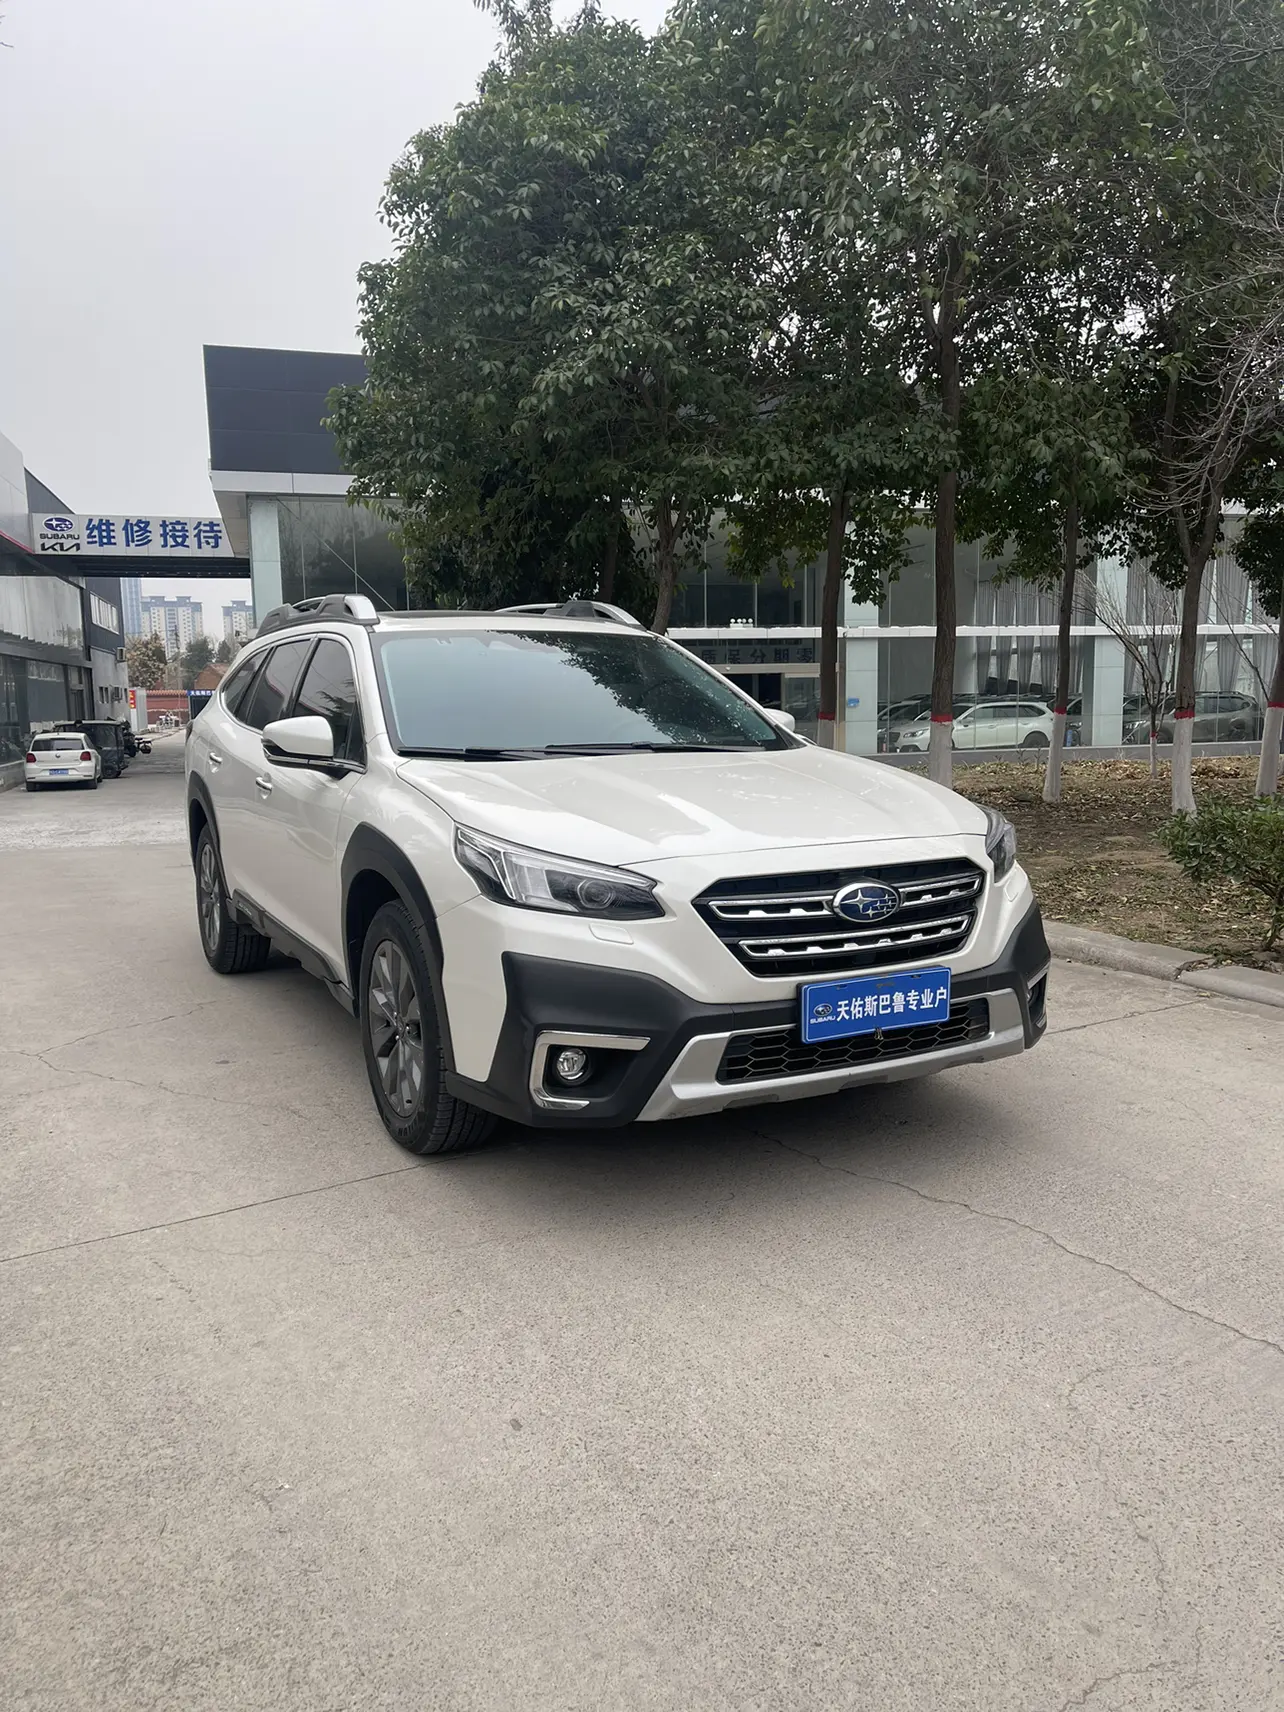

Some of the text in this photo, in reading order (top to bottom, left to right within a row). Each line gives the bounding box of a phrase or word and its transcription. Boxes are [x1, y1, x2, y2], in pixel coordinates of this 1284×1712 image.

[39, 532, 80, 540] SUBARU
[85, 518, 223, 550] 维修接待
[40, 541, 81, 552] KIA
[836, 986, 947, 1022] 天佑斯巴鲁专业户
[809, 1015, 837, 1025] SUBARU
